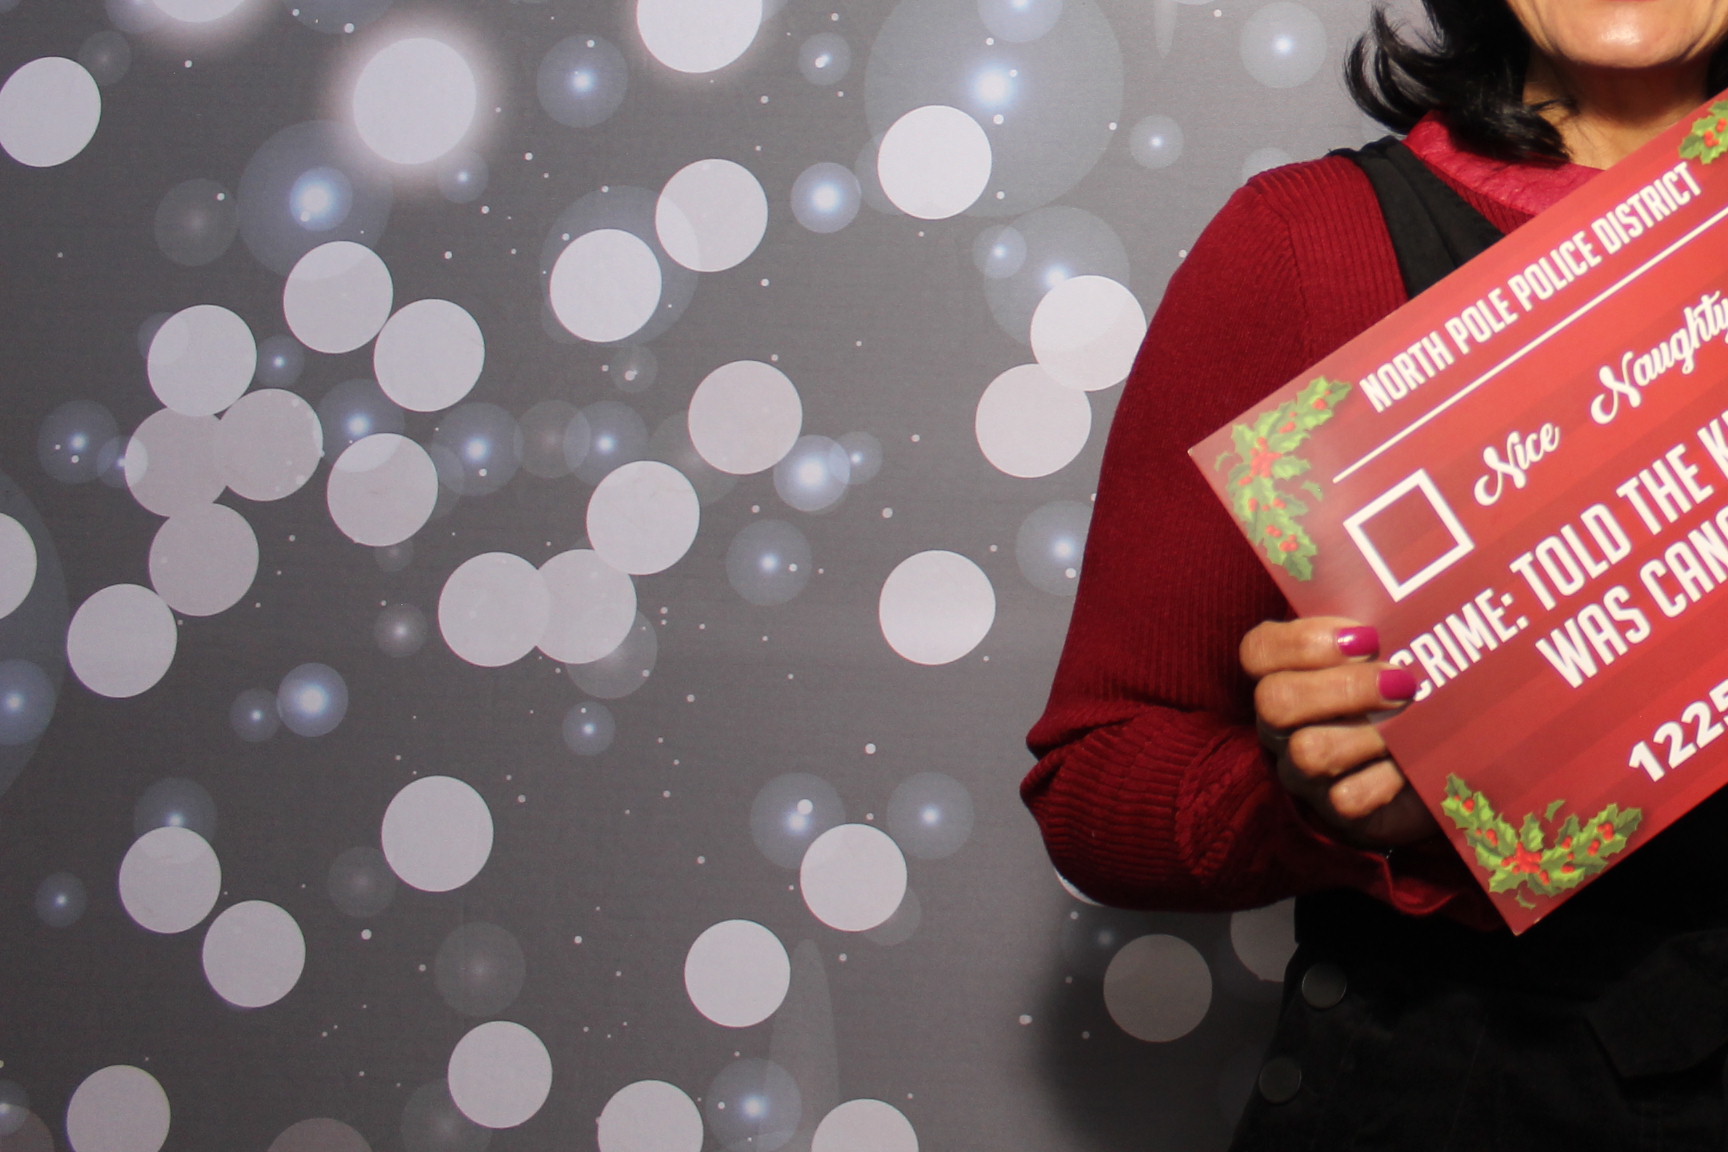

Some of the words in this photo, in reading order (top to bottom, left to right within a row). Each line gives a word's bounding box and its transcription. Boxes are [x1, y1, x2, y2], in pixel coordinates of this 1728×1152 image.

[1359, 330, 1455, 413] NORTH
[1444, 287, 1519, 355] POLE
[1507, 230, 1602, 312] POLICE
[1591, 161, 1701, 255] DISTRICT
[1473, 422, 1560, 506] Nice
[1389, 588, 1529, 702] CRIME:
[1509, 503, 1632, 611] TOLD
[1615, 443, 1714, 536] THE
[1535, 585, 1651, 688] WAS
